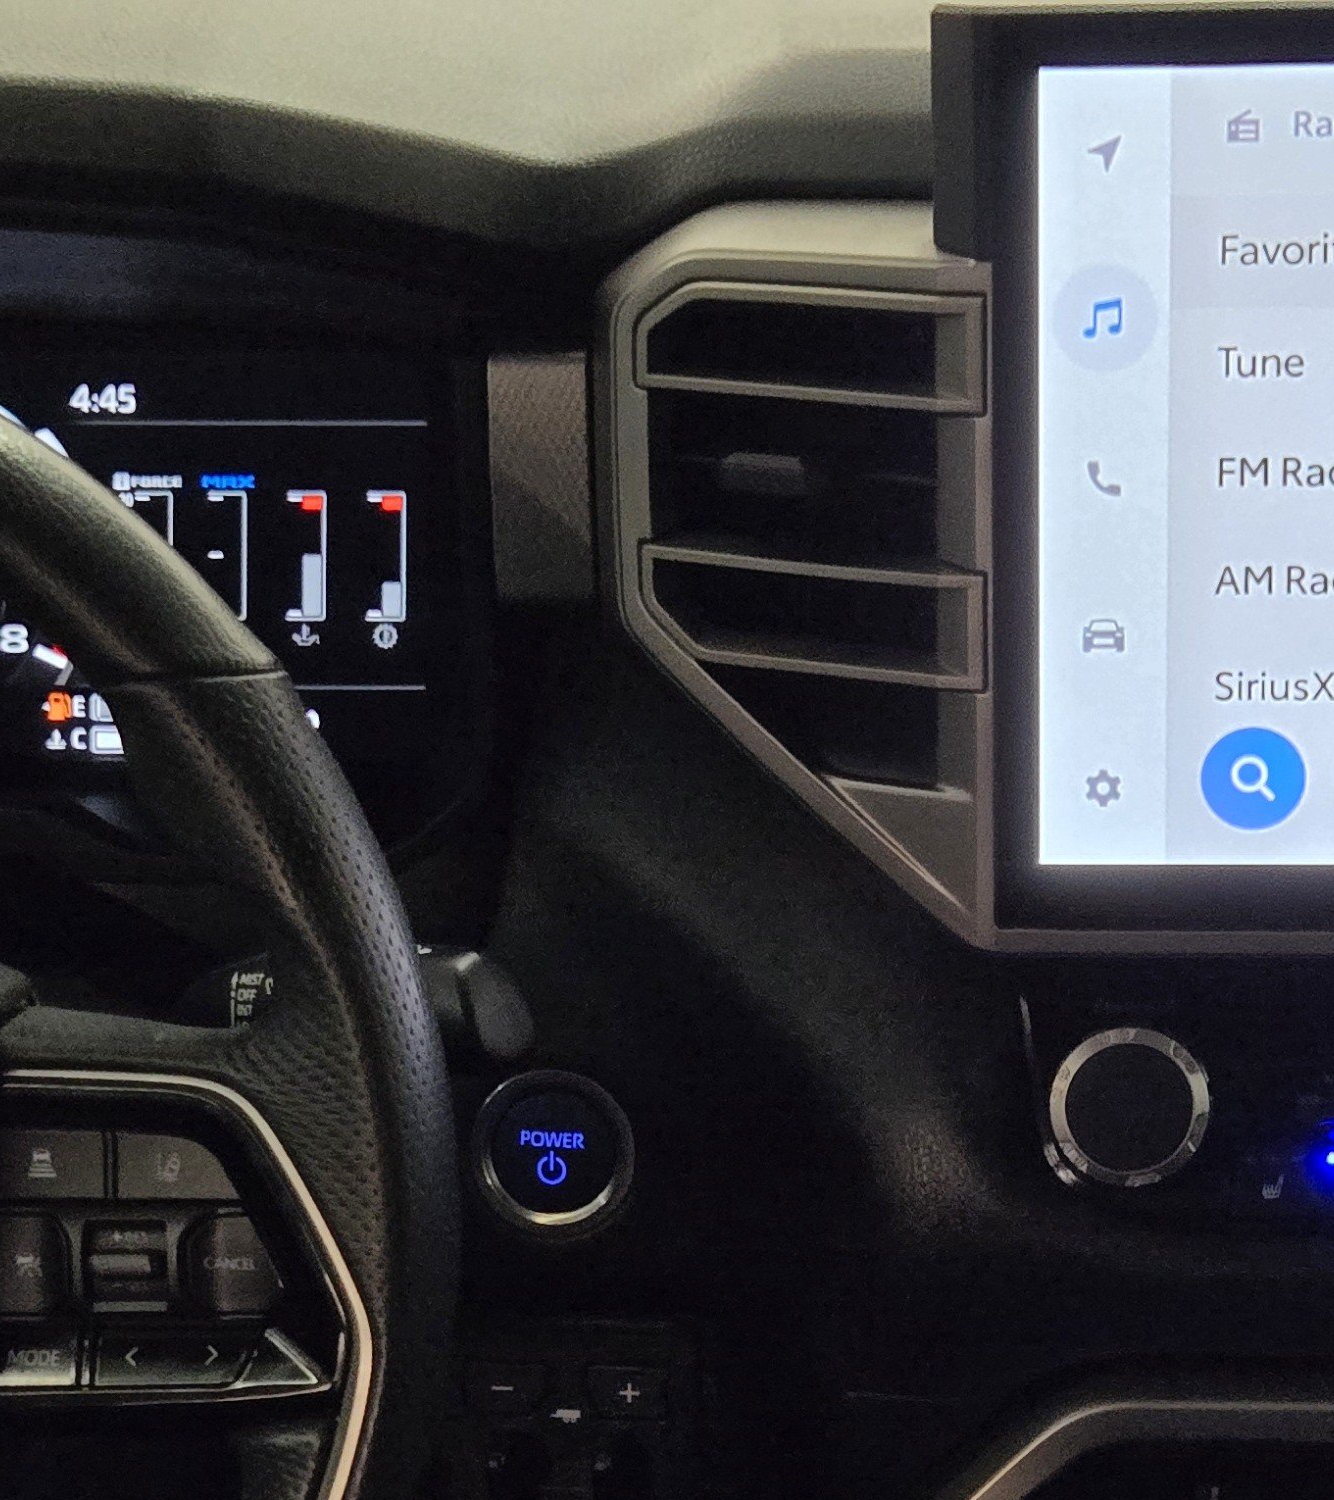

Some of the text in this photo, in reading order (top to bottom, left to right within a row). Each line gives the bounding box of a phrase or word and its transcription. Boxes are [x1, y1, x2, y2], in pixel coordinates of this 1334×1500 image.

[1218, 346, 1306, 379] Tune
[69, 383, 138, 415] 4:45
[1218, 457, 1270, 488] FM
[1215, 565, 1275, 596] AM
[71, 694, 87, 718] E
[70, 727, 87, 750] C
[519, 1129, 586, 1150] POWER
[6, 1348, 62, 1367] MODE
